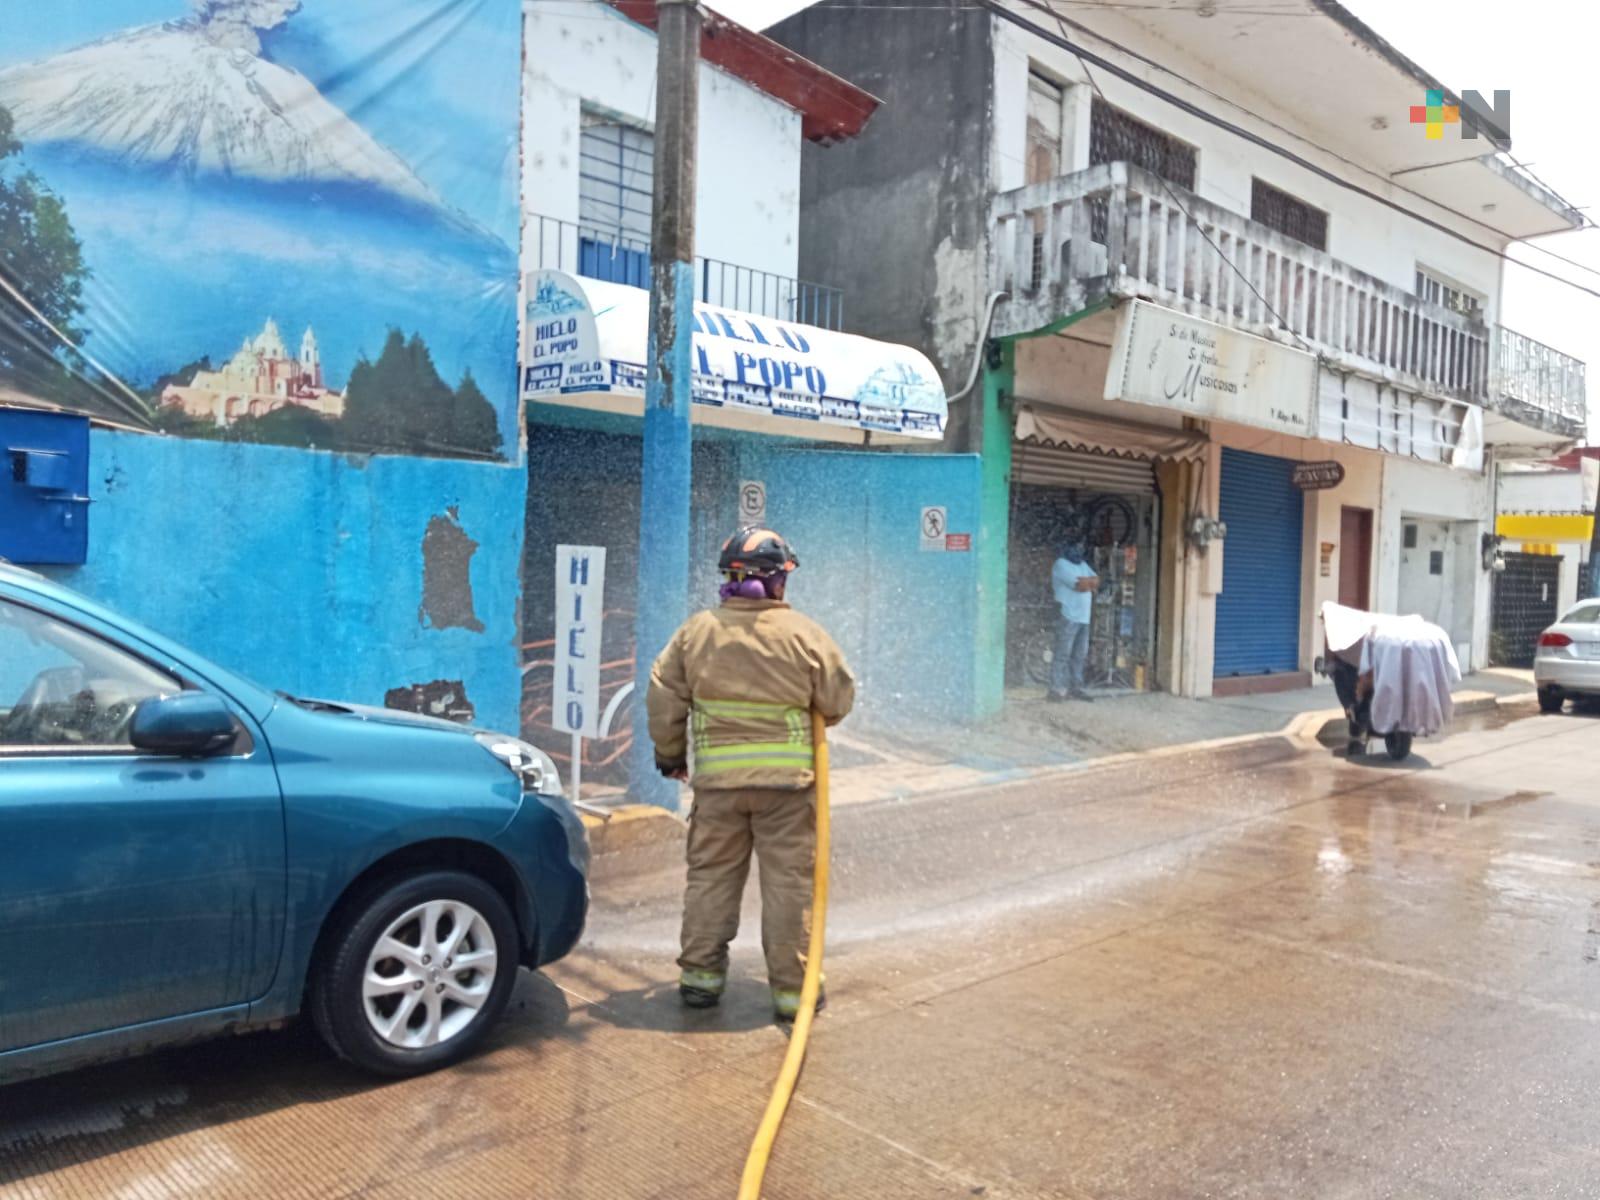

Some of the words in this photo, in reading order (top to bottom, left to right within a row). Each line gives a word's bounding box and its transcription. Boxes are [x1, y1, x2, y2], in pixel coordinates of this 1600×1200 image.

[536, 318, 577, 341] HIELO
[533, 344, 546, 358] EL
[551, 338, 578, 355] POPO
[568, 361, 602, 375] HIELO
[692, 344, 724, 377] L
[734, 350, 826, 395] POPO
[566, 555, 589, 731] HIELO
